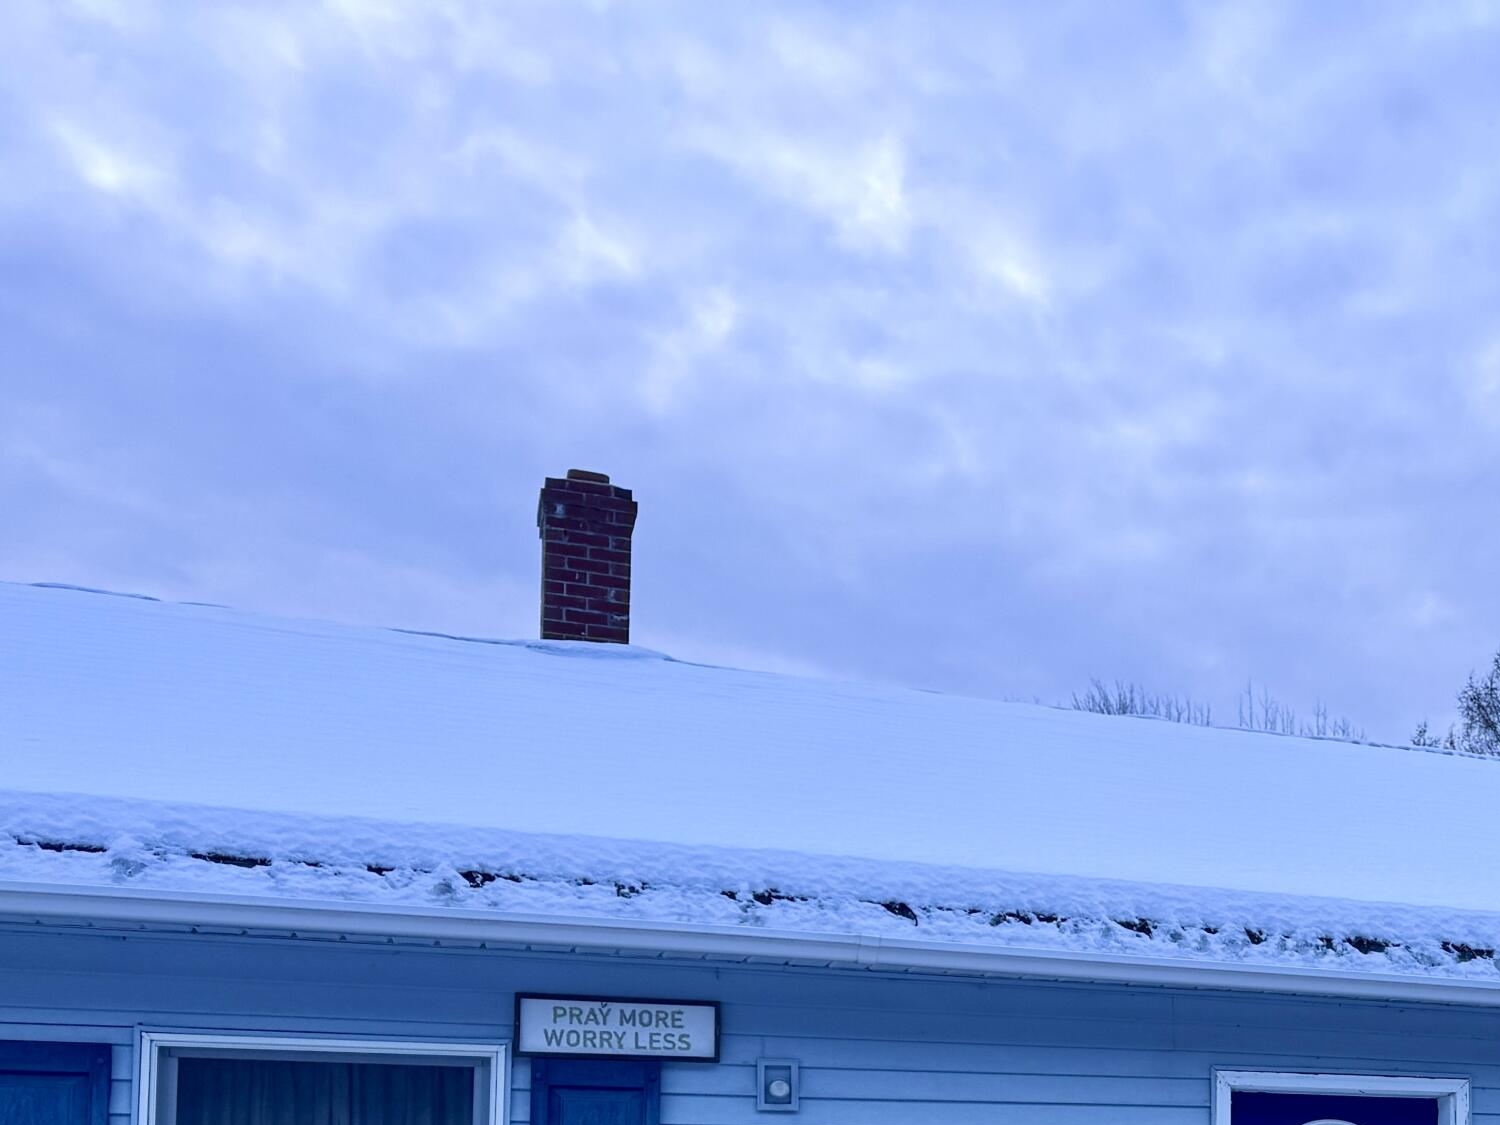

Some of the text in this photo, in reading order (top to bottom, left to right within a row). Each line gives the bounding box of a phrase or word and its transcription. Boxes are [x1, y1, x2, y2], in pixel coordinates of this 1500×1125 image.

[552, 1006, 684, 1028] PRAY MORE
[544, 1028, 692, 1051] WORRY LESS
